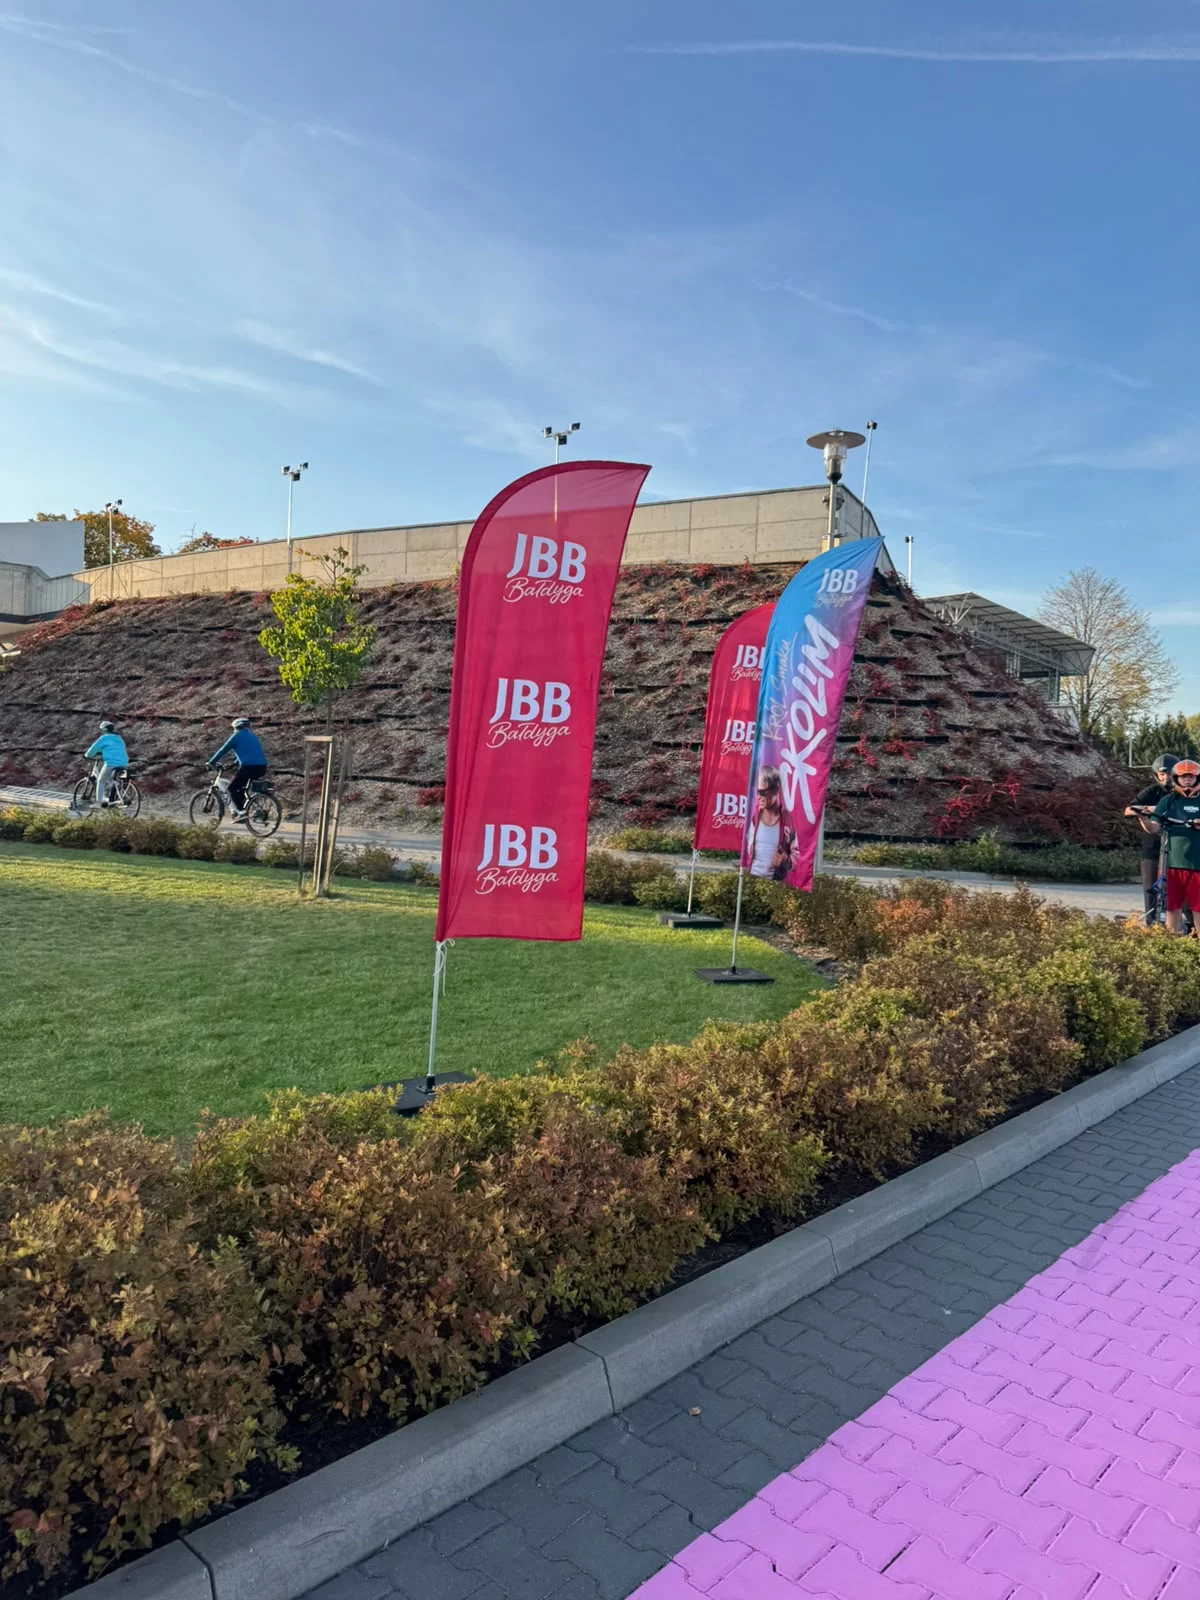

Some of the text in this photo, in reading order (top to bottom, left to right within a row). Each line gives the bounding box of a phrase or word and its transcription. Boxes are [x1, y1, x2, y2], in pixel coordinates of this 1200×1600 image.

[506, 532, 587, 584] JBB
[816, 568, 858, 594] JBB
[489, 677, 572, 724] JBB
[779, 614, 840, 825] SKOLIM
[477, 823, 559, 871] JBB
